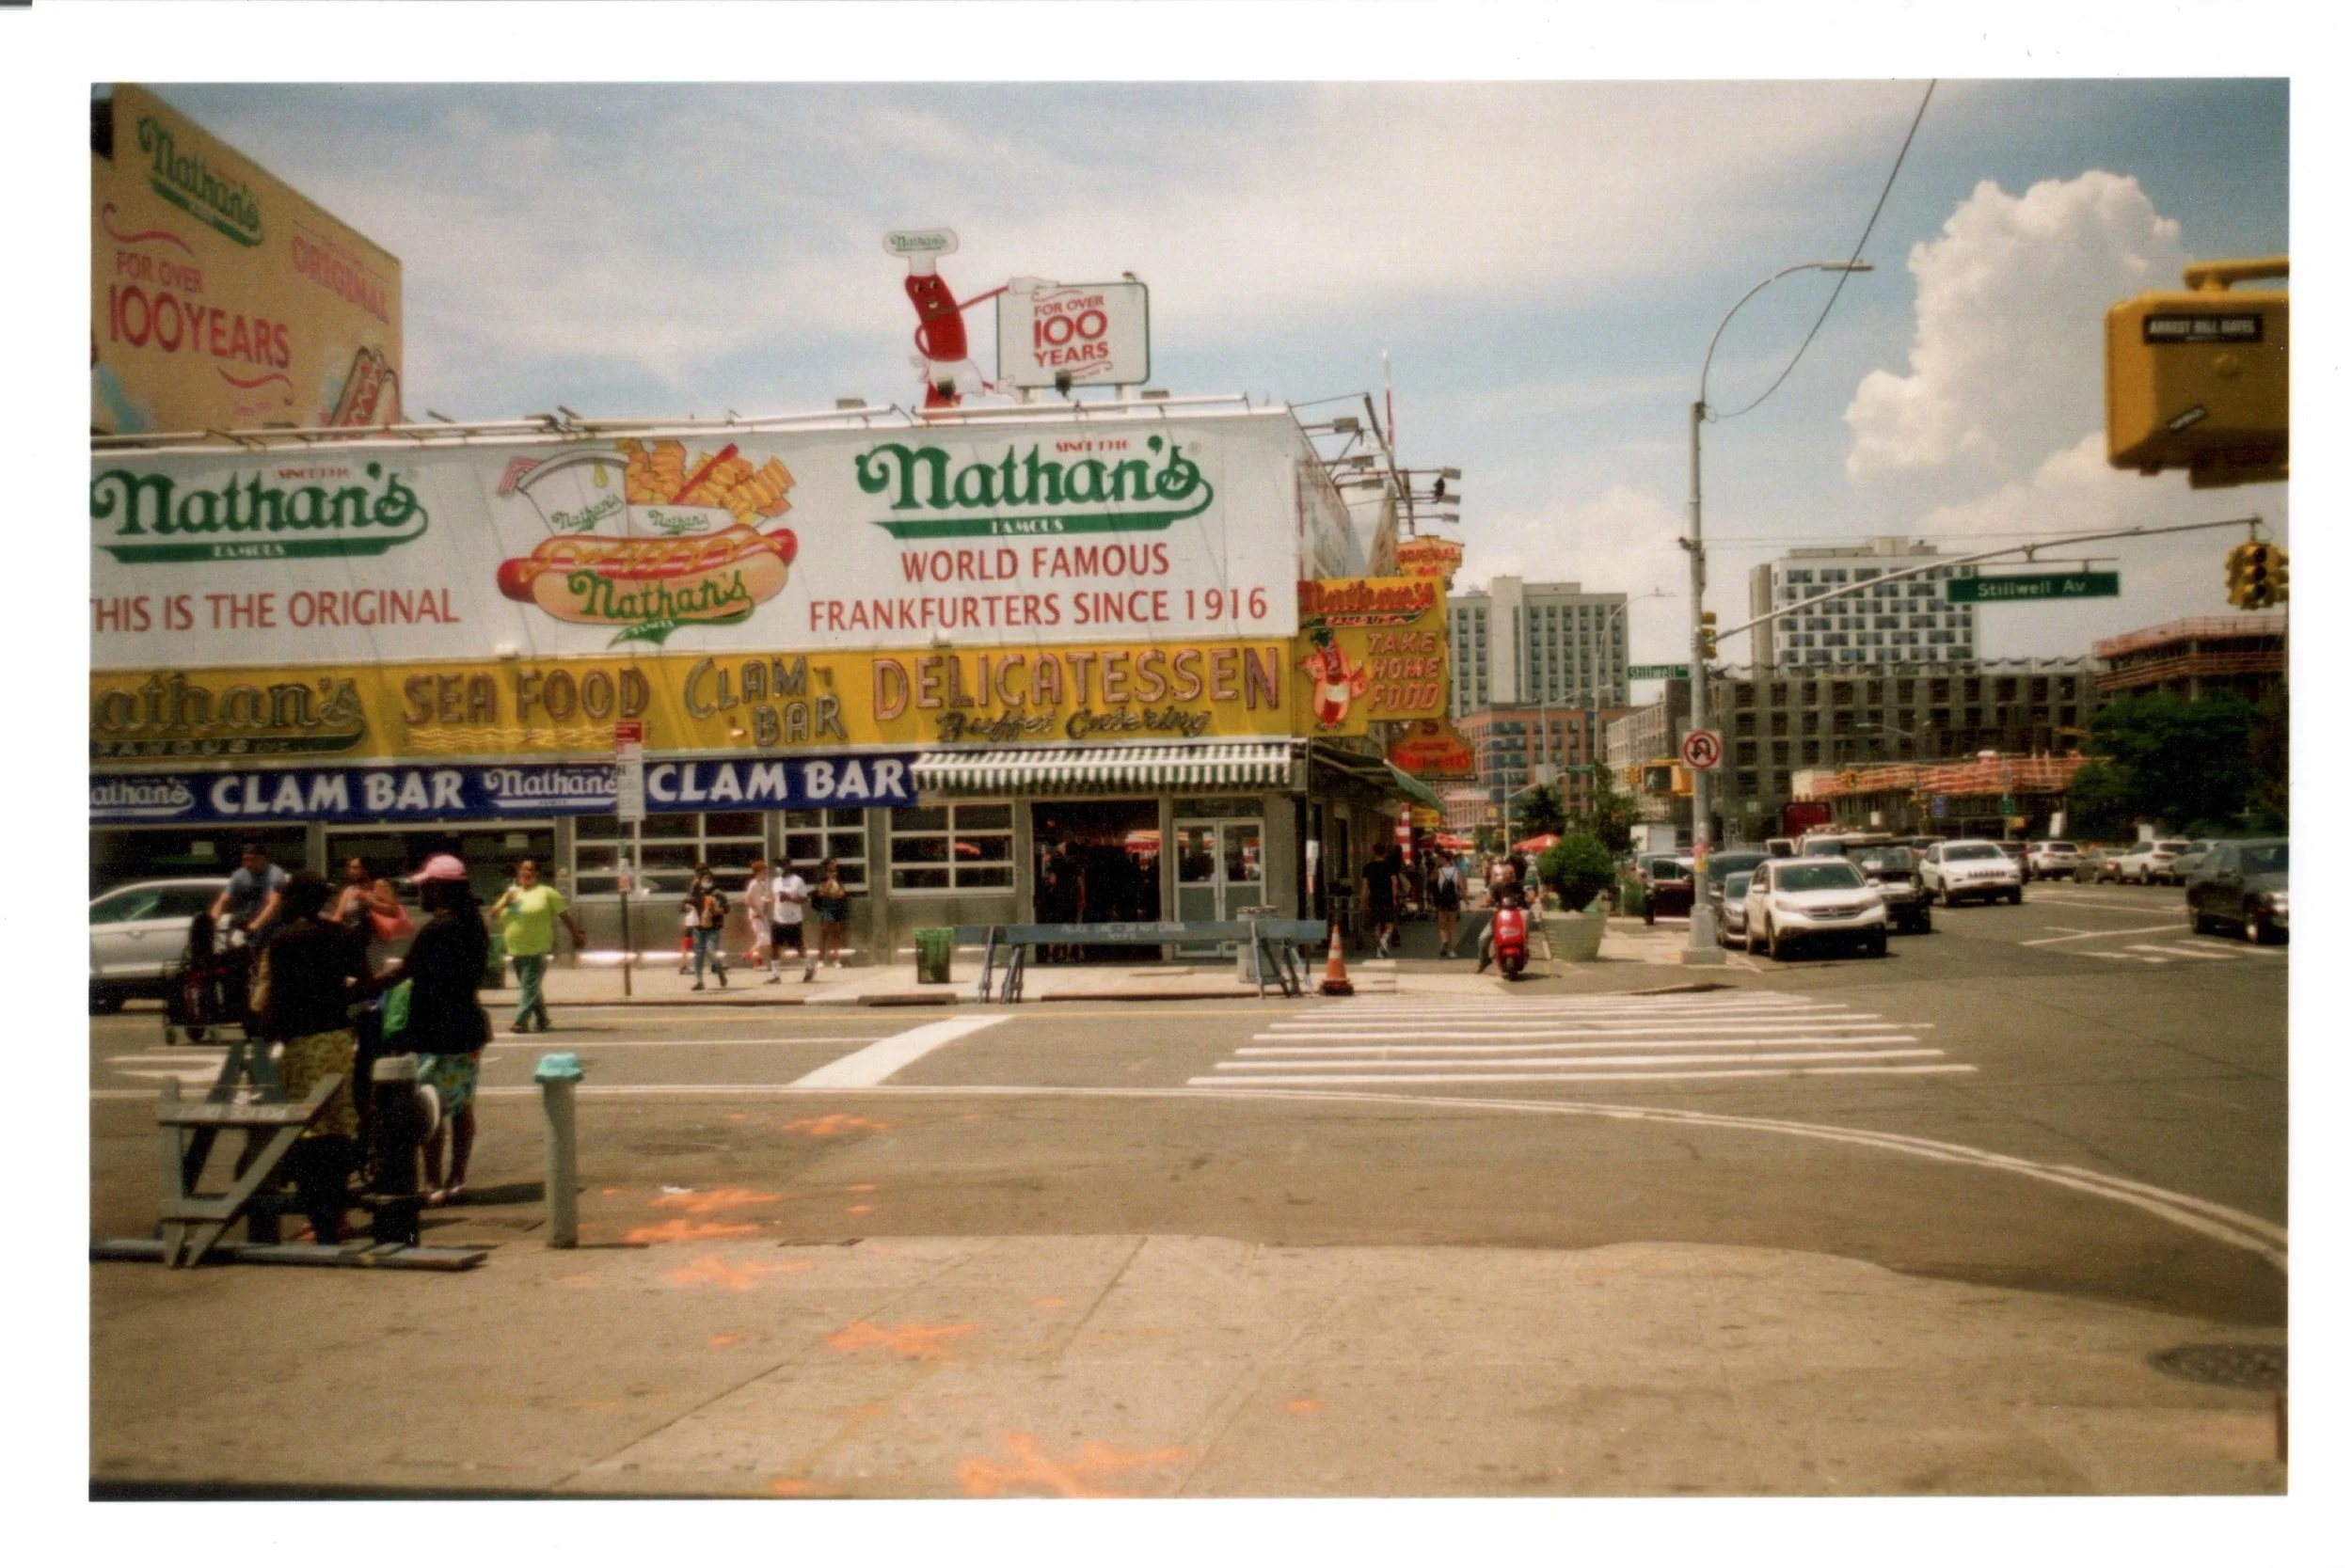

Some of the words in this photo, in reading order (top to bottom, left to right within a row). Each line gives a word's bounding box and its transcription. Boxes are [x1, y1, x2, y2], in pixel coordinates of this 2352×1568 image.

[137, 116, 261, 233] Nathan's
[116, 249, 154, 280] FOR
[159, 261, 204, 293] OVER
[1034, 302, 1063, 317] FOR
[1067, 294, 1104, 311] OVER
[1033, 309, 1108, 348] 100
[1033, 341, 1109, 369] YEARS
[856, 436, 1200, 511] Nathan's
[91, 462, 418, 536] Nathan's
[992, 518, 1064, 535] FAMOUS
[214, 544, 286, 559] FAMOUS
[900, 548, 1019, 583] WORLD
[1033, 543, 1169, 578] FAMOUS
[90, 596, 151, 631] HIS
[166, 594, 193, 631] IS
[205, 593, 277, 629] THE
[288, 588, 461, 627] ORIGINAL
[567, 569, 749, 619] Nathan's
[810, 594, 1060, 632] FRANKFURTERS
[1073, 590, 1168, 625] SINCE
[1184, 586, 1268, 621] 1916
[1978, 580, 2051, 597] Stillwell
[2062, 579, 2087, 593] Av
[1368, 632, 1437, 655] TAKE
[684, 657, 807, 719] CLAM
[872, 647, 1279, 721] DELICATESSEN
[1372, 657, 1441, 679] HOME
[91, 672, 365, 732] athan's
[404, 672, 497, 725] SEA
[516, 666, 650, 722] FOOD
[1368, 683, 1439, 711] FOOD
[755, 693, 848, 746] BAR
[936, 707, 1057, 742] Buffet
[1066, 705, 1213, 739] Catering
[90, 776, 191, 806] athan's
[211, 774, 349, 814] CLAM
[364, 770, 465, 811] BAR
[648, 763, 787, 802] CLAM
[804, 757, 909, 800] BAR
